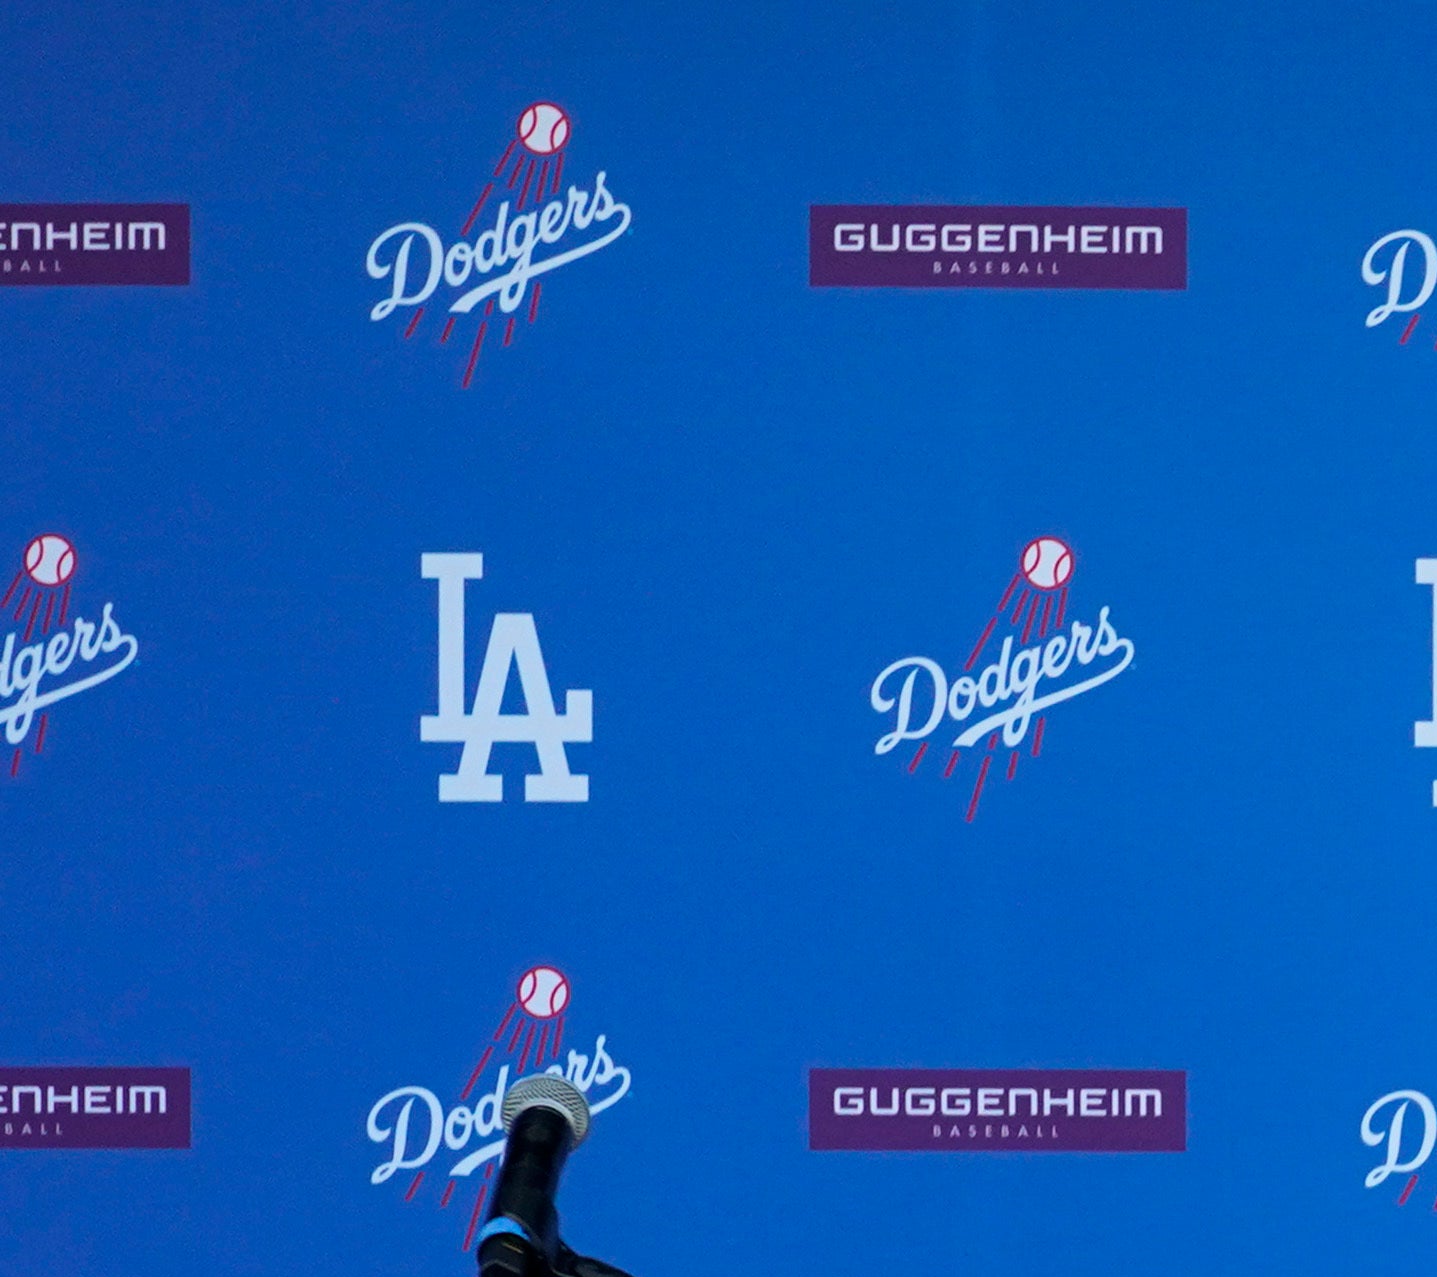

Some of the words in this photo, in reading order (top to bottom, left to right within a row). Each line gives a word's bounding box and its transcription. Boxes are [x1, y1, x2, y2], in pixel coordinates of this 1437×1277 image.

[0, 221, 166, 251] NHEIM
[365, 170, 632, 321] Dodgers
[833, 223, 1163, 254] GUGGENHEIM
[3, 259, 61, 273] BALL
[933, 261, 1059, 275] BASEBALL
[419, 552, 594, 803] LA
[870, 605, 1135, 755] Dodgers
[0, 1085, 167, 1114] NHEIM
[833, 1087, 1162, 1117] GUGGENHEIM
[4, 1122, 62, 1136] BALL
[932, 1124, 1058, 1138] BASEBALL
